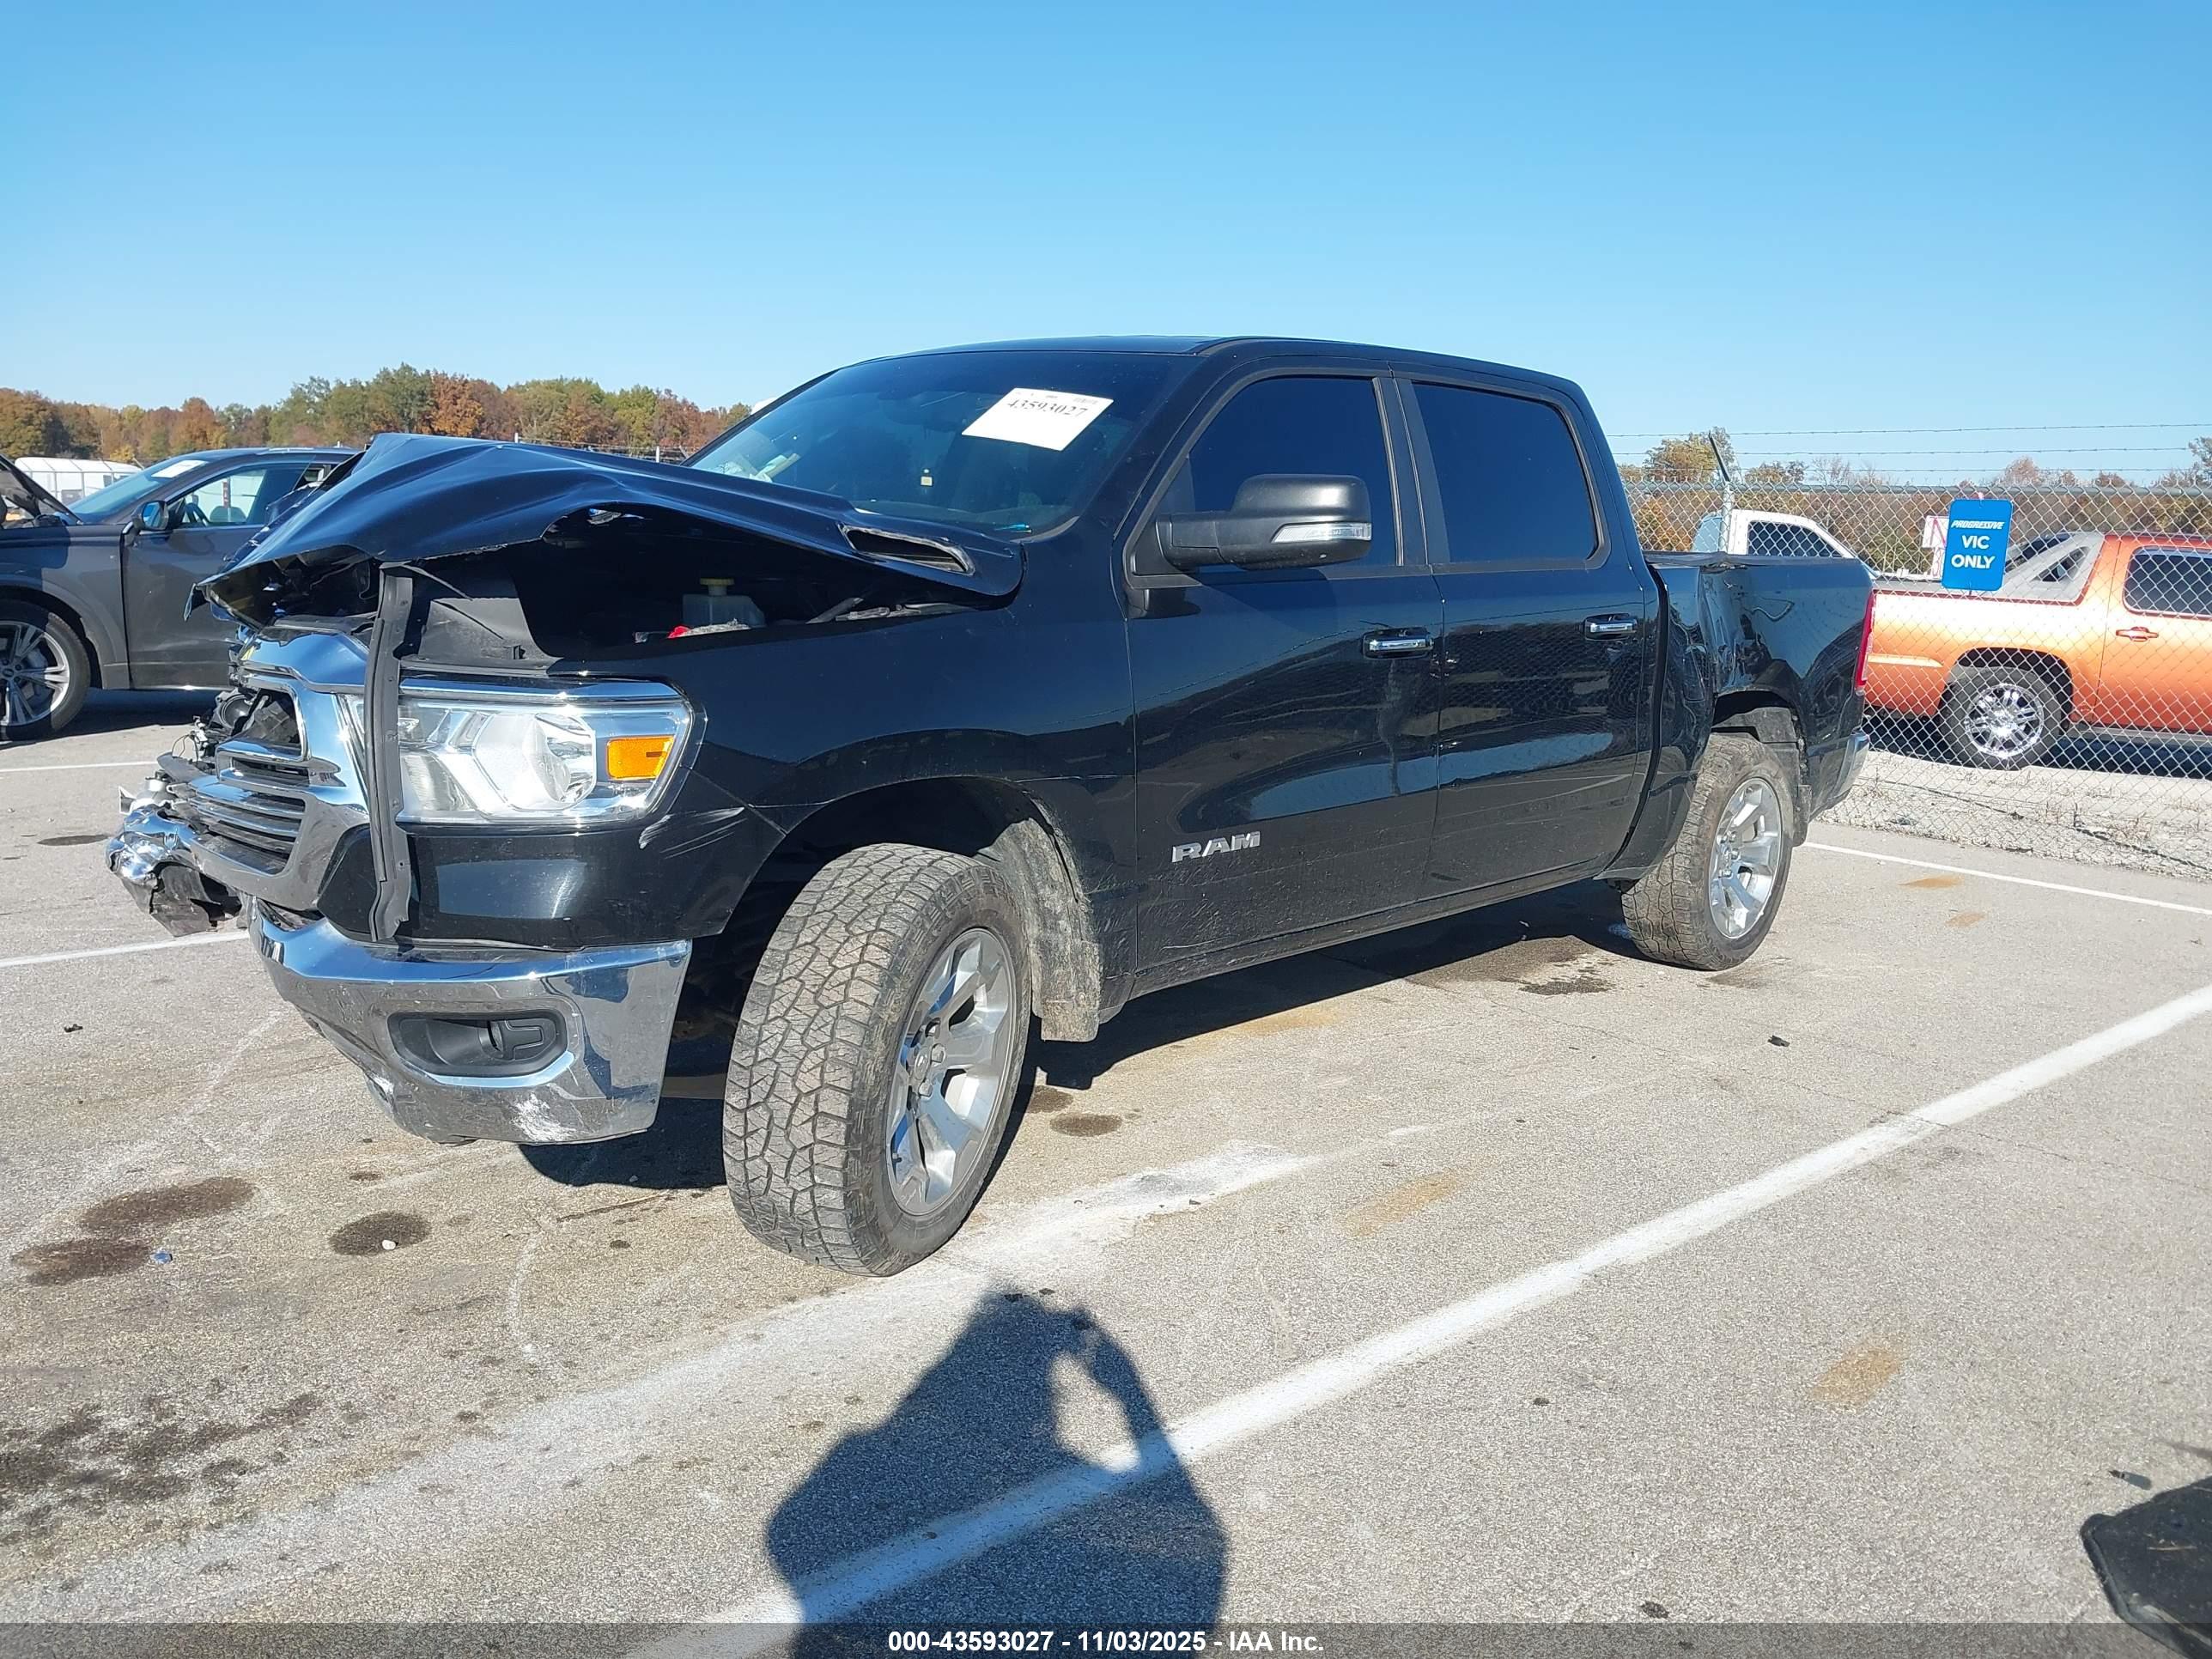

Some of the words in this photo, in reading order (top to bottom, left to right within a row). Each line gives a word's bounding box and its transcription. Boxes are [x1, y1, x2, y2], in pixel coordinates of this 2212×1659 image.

[1007, 398, 1089, 417] 43593027
[1951, 520, 2005, 530] PROGRESSIVE
[1961, 535, 1990, 550] VIC
[1951, 554, 1996, 568] ONLY
[1171, 830, 1261, 863] RAM
